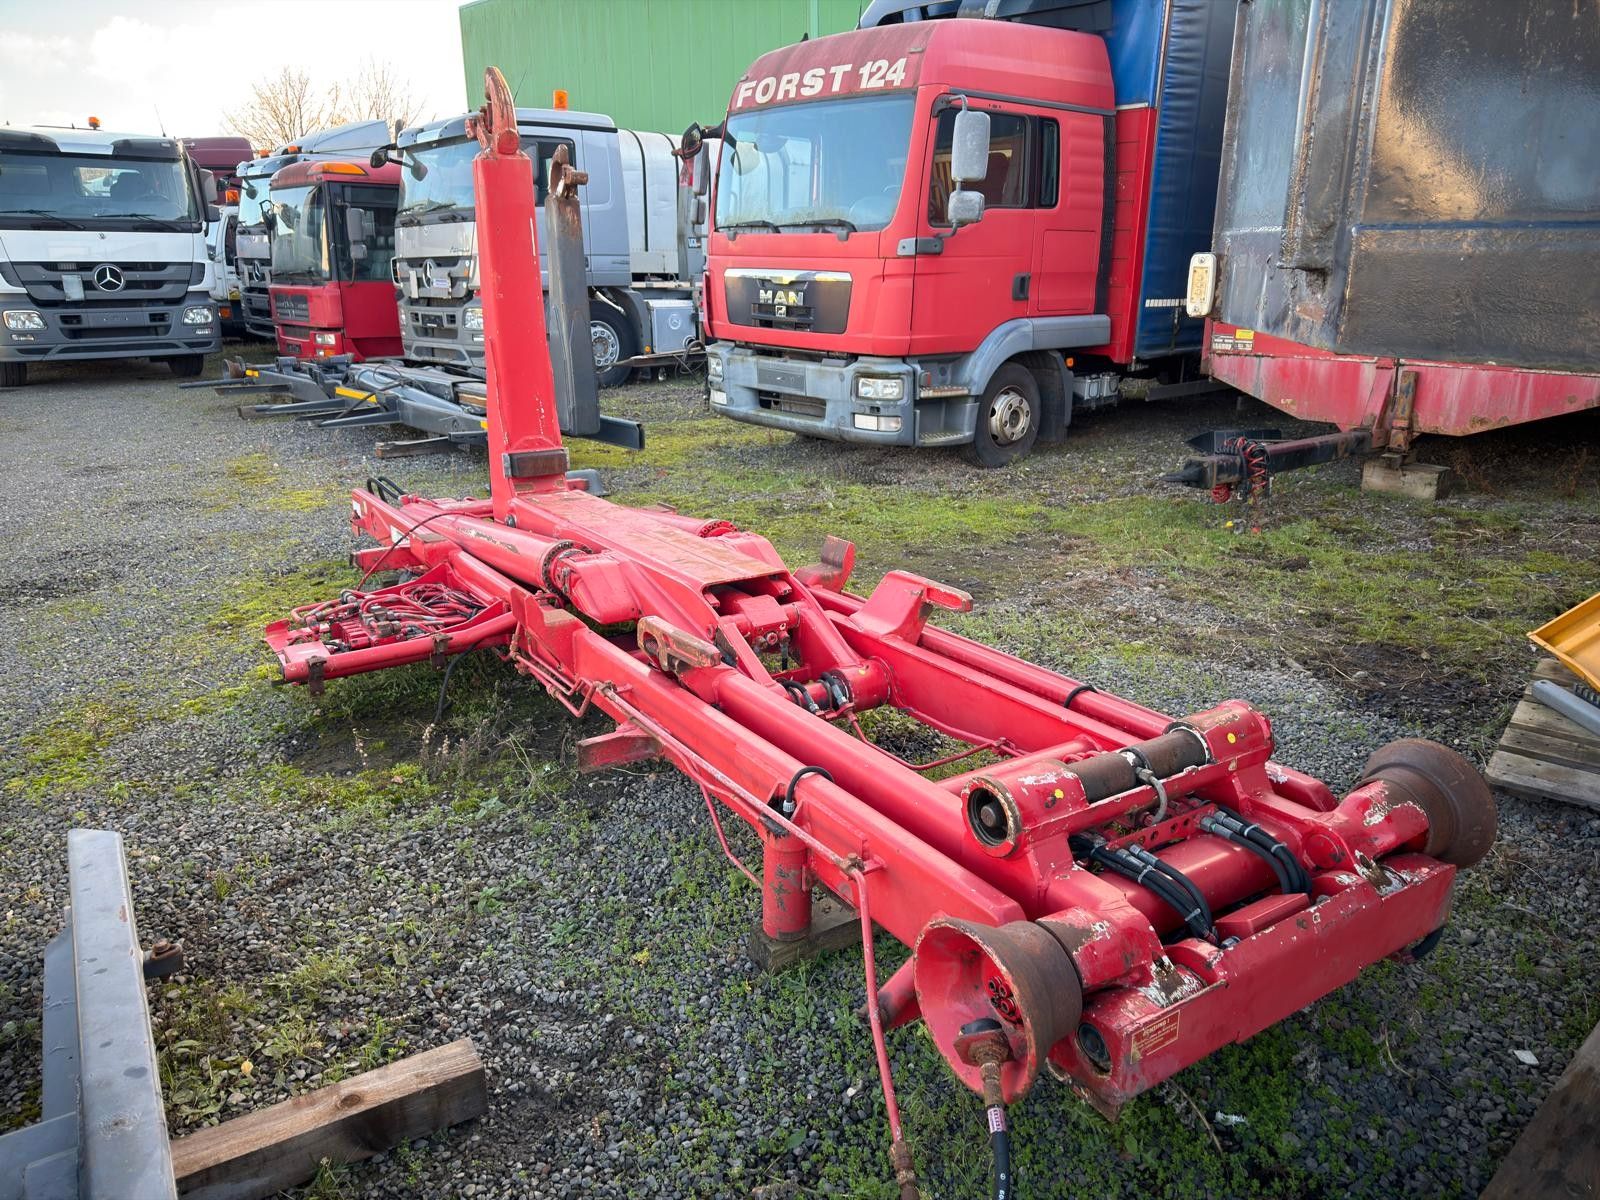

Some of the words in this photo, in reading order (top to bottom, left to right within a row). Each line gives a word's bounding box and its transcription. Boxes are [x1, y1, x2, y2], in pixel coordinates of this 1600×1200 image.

[736, 64, 852, 108] FORST
[858, 57, 907, 89] 124
[760, 289, 804, 306] MAN
